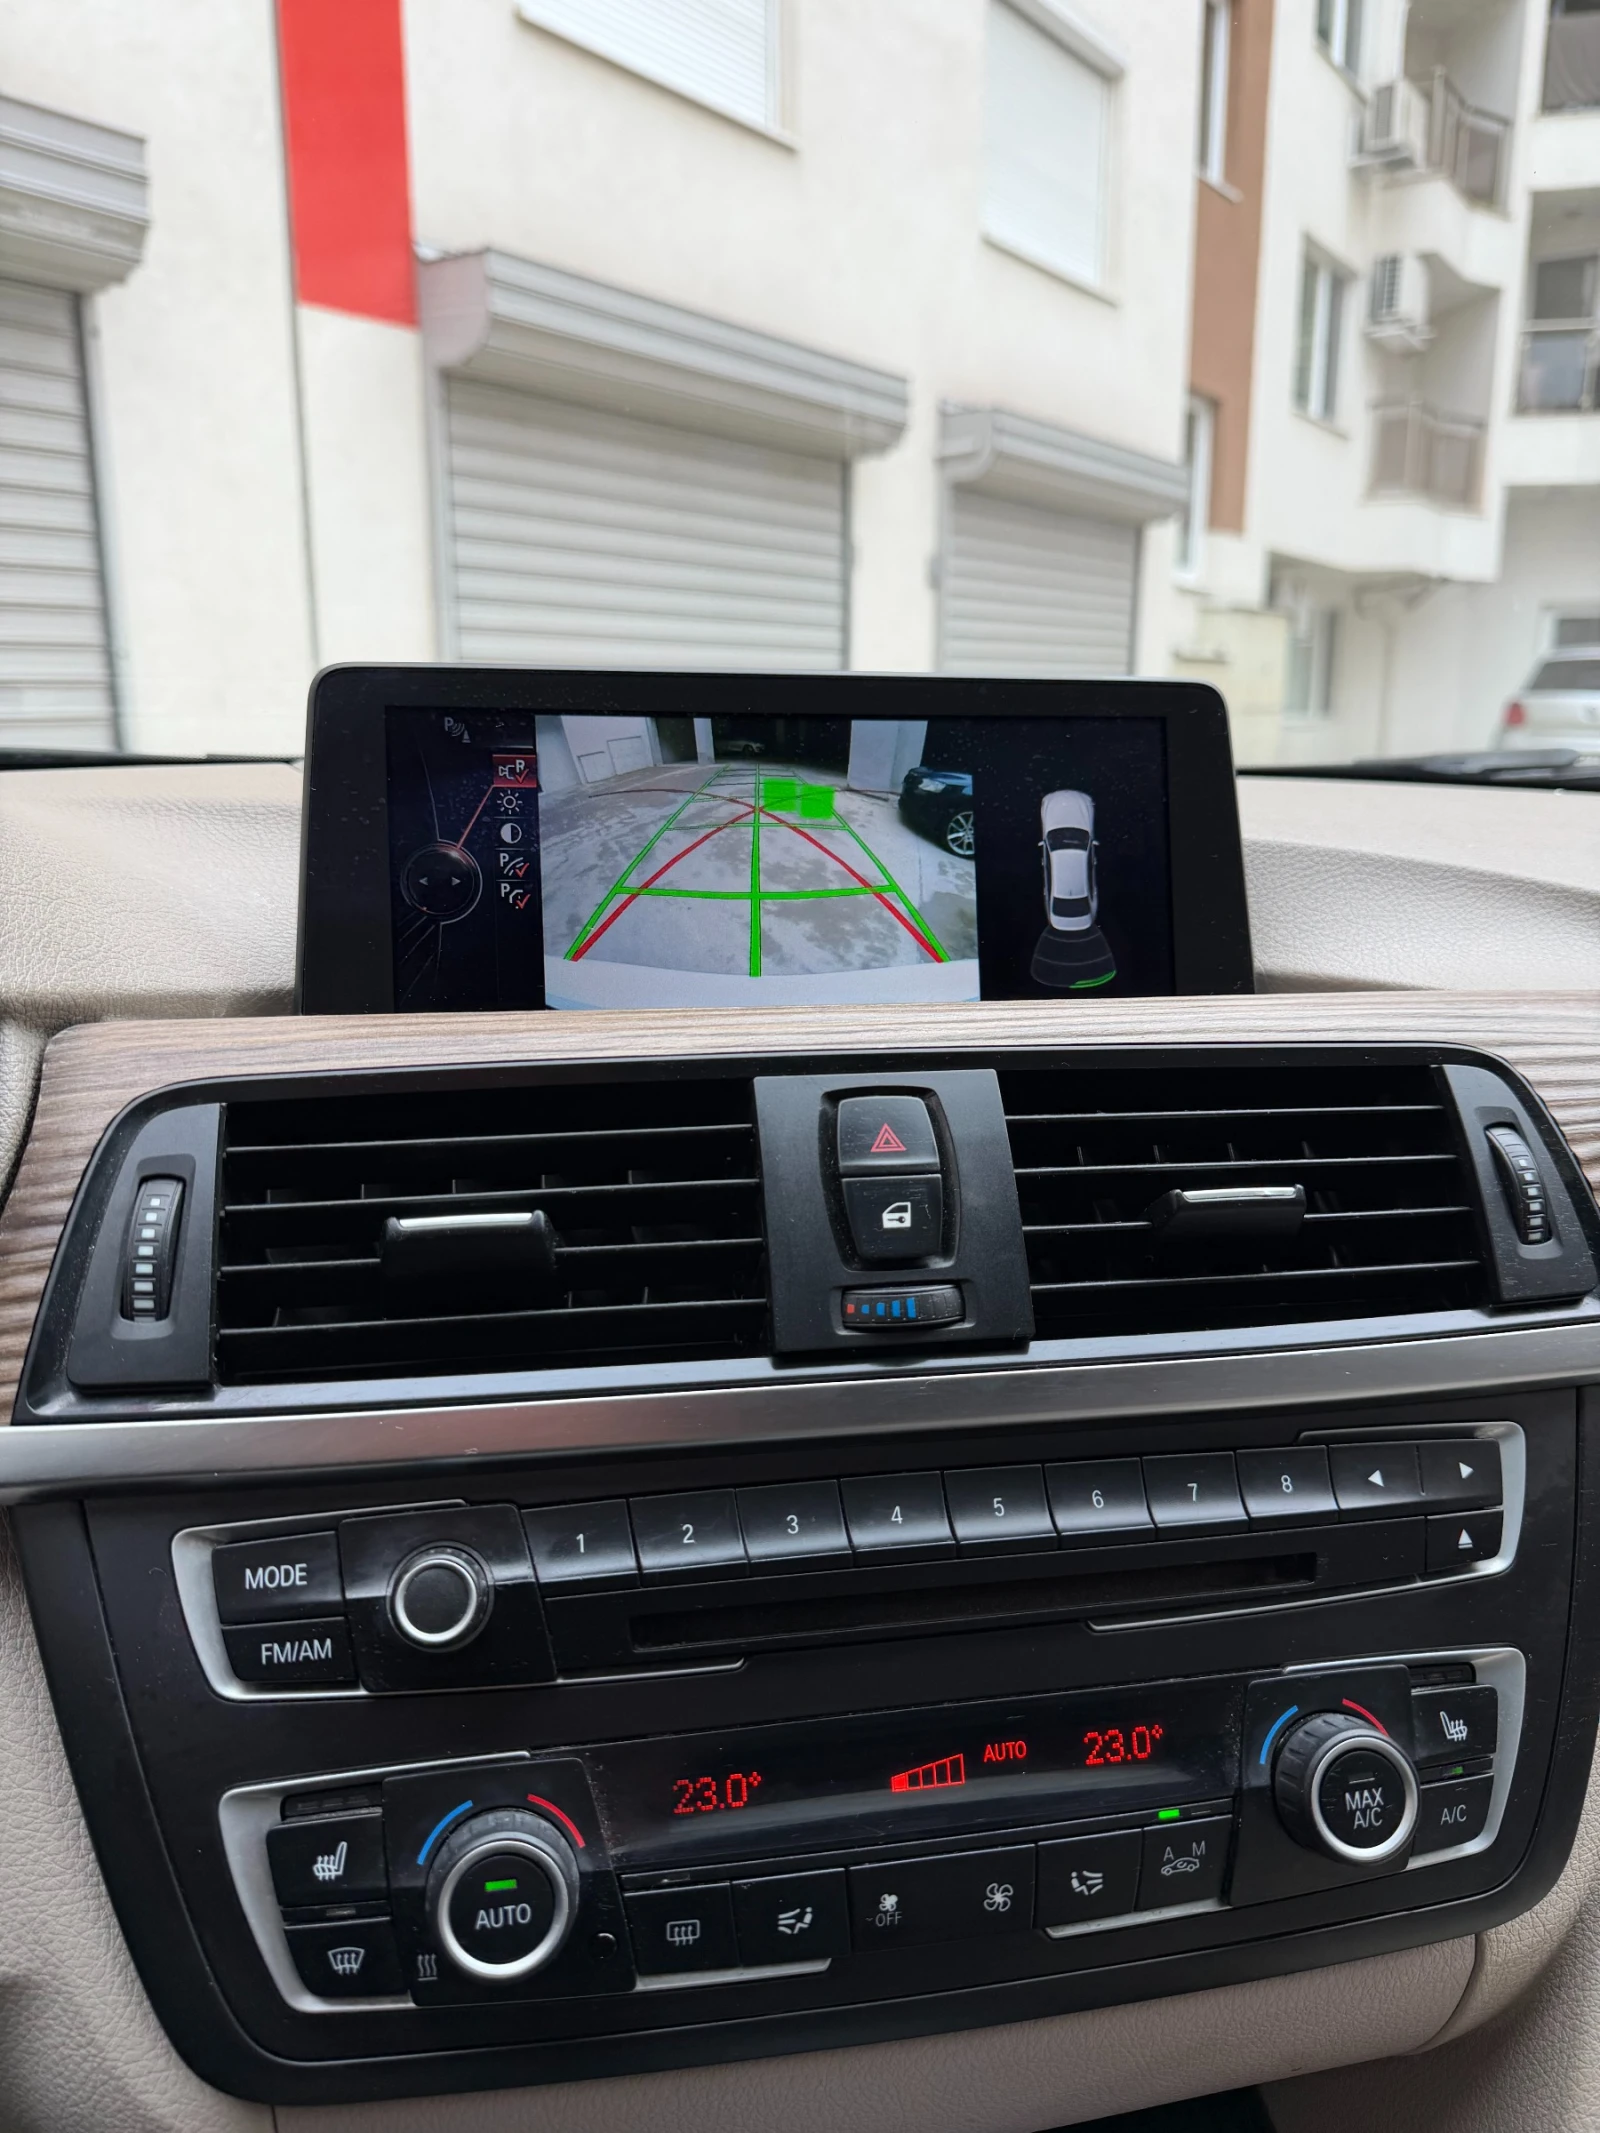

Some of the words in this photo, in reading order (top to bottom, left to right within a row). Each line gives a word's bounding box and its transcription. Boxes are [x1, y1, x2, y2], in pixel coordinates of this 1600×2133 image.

[1187, 1482, 1199, 1502] 7
[1281, 1475, 1293, 1494] 8
[992, 1497, 1005, 1517] 5
[1091, 1489, 1104, 1509] 6
[786, 1515, 800, 1535] 3
[890, 1505, 904, 1525] 4
[576, 1533, 585, 1554] 1
[681, 1524, 696, 1544] 2
[244, 1563, 308, 1590] MODE
[260, 1638, 332, 1665] FM/AM
[983, 1740, 1027, 1763] AUTO
[1345, 1787, 1384, 1811] MAX
[1353, 1807, 1383, 1830] A/C
[1440, 1804, 1467, 1825] A/C
[1163, 1846, 1174, 1861] A
[1192, 1840, 1206, 1856] M
[475, 1903, 532, 1931] AUTO
[875, 1911, 903, 1927] OFF
